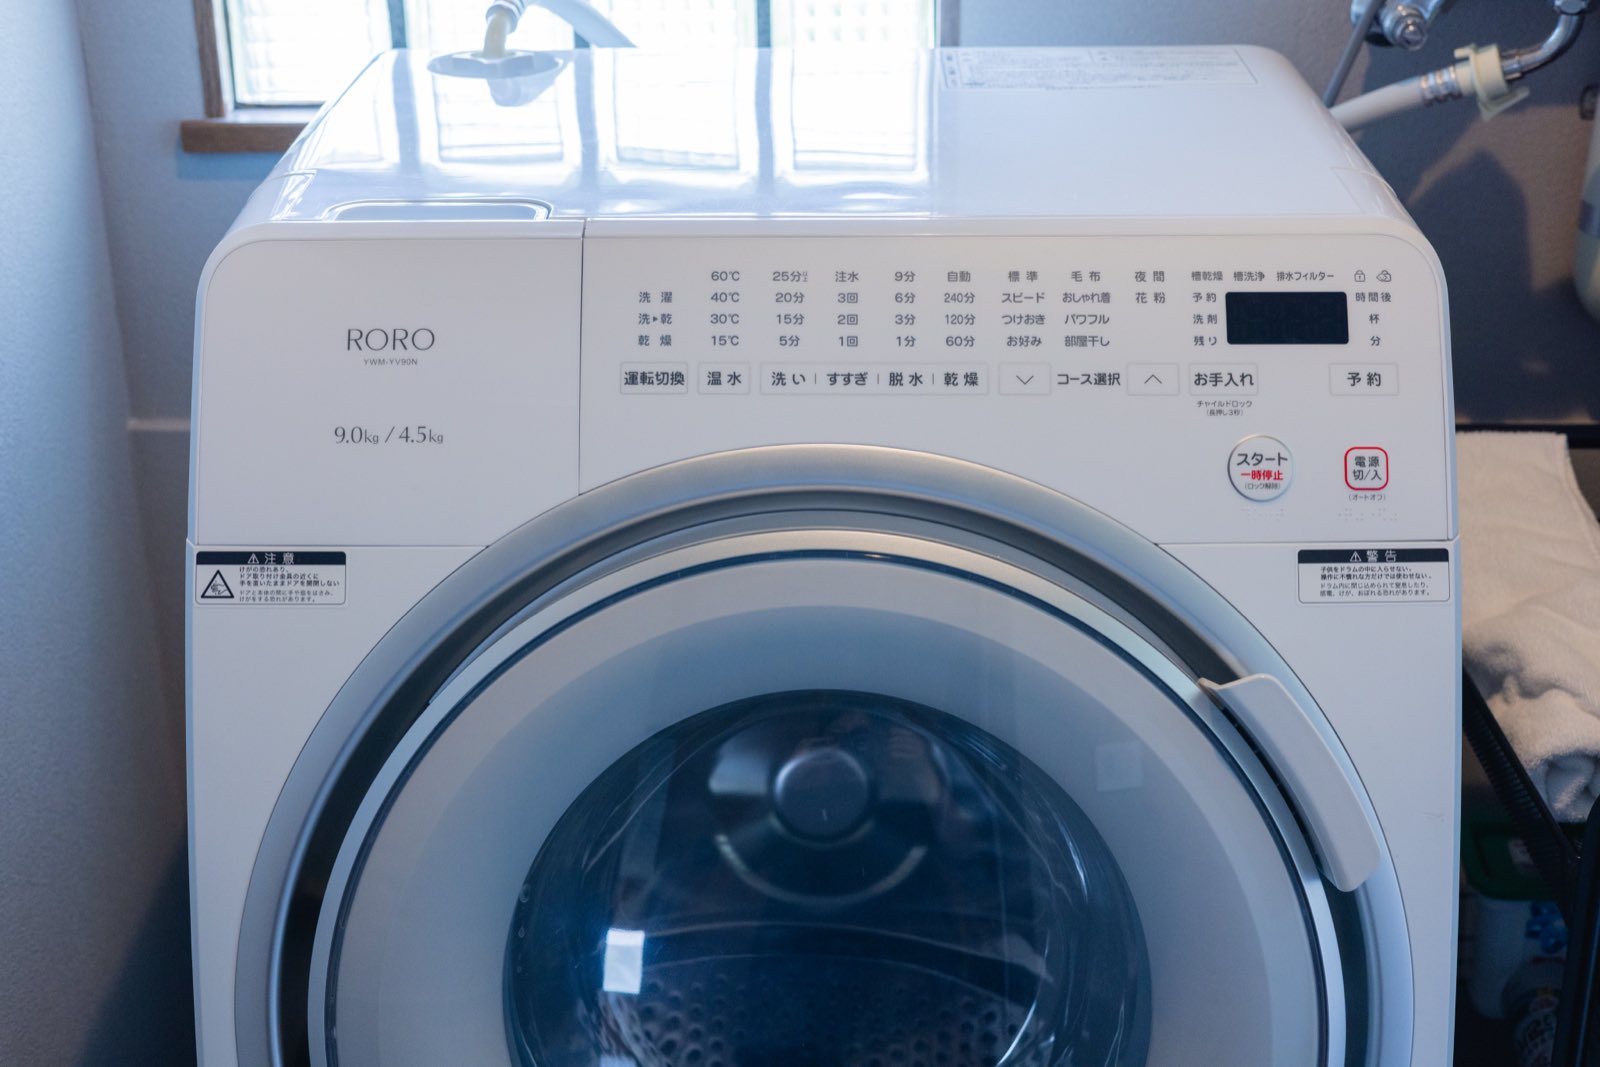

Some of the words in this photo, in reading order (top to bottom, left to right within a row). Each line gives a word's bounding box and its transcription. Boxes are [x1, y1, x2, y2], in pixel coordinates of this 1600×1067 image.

[711, 271, 740, 281] 60℃
[835, 271, 859, 282] 注水
[895, 271, 915, 282] 9分
[947, 271, 971, 282] 自動
[1191, 271, 1223, 281] 槽乾燥
[1233, 271, 1265, 281] 槽洗浄
[1277, 271, 1334, 281] 排水フィルター
[711, 292, 739, 302] 40℃
[776, 292, 805, 303] 20分
[838, 293, 858, 303] 3回
[895, 292, 915, 303] 6分
[944, 292, 975, 304] 240分
[1002, 292, 1044, 303] スピード
[1062, 292, 1111, 303] おしゃれ着
[710, 313, 739, 324] 30℃
[777, 314, 804, 325] 15分
[837, 314, 858, 325] 2回
[895, 314, 916, 325] 3分
[945, 314, 976, 325] 120分
[1002, 314, 1046, 325] つけおき
[1065, 314, 1109, 325] パワフル
[1369, 314, 1379, 324] 杯
[347, 328, 435, 351] RORO
[712, 335, 739, 346] 15℃
[779, 335, 800, 347] 5分
[839, 336, 858, 347] 1回
[896, 336, 916, 347] 1分
[946, 336, 975, 347] 60分
[1007, 336, 1042, 347] お好み
[1065, 336, 1110, 347] 部屋干し
[1370, 336, 1380, 346] 分
[624, 371, 684, 385] 運転切換
[827, 372, 868, 386] すすぎ
[1057, 373, 1120, 386] コース選択
[1194, 373, 1254, 387] お手入れ
[1197, 400, 1252, 408] チャイルドロック
[1237, 452, 1288, 466] スタート
[1241, 470, 1283, 481] 一時停止
